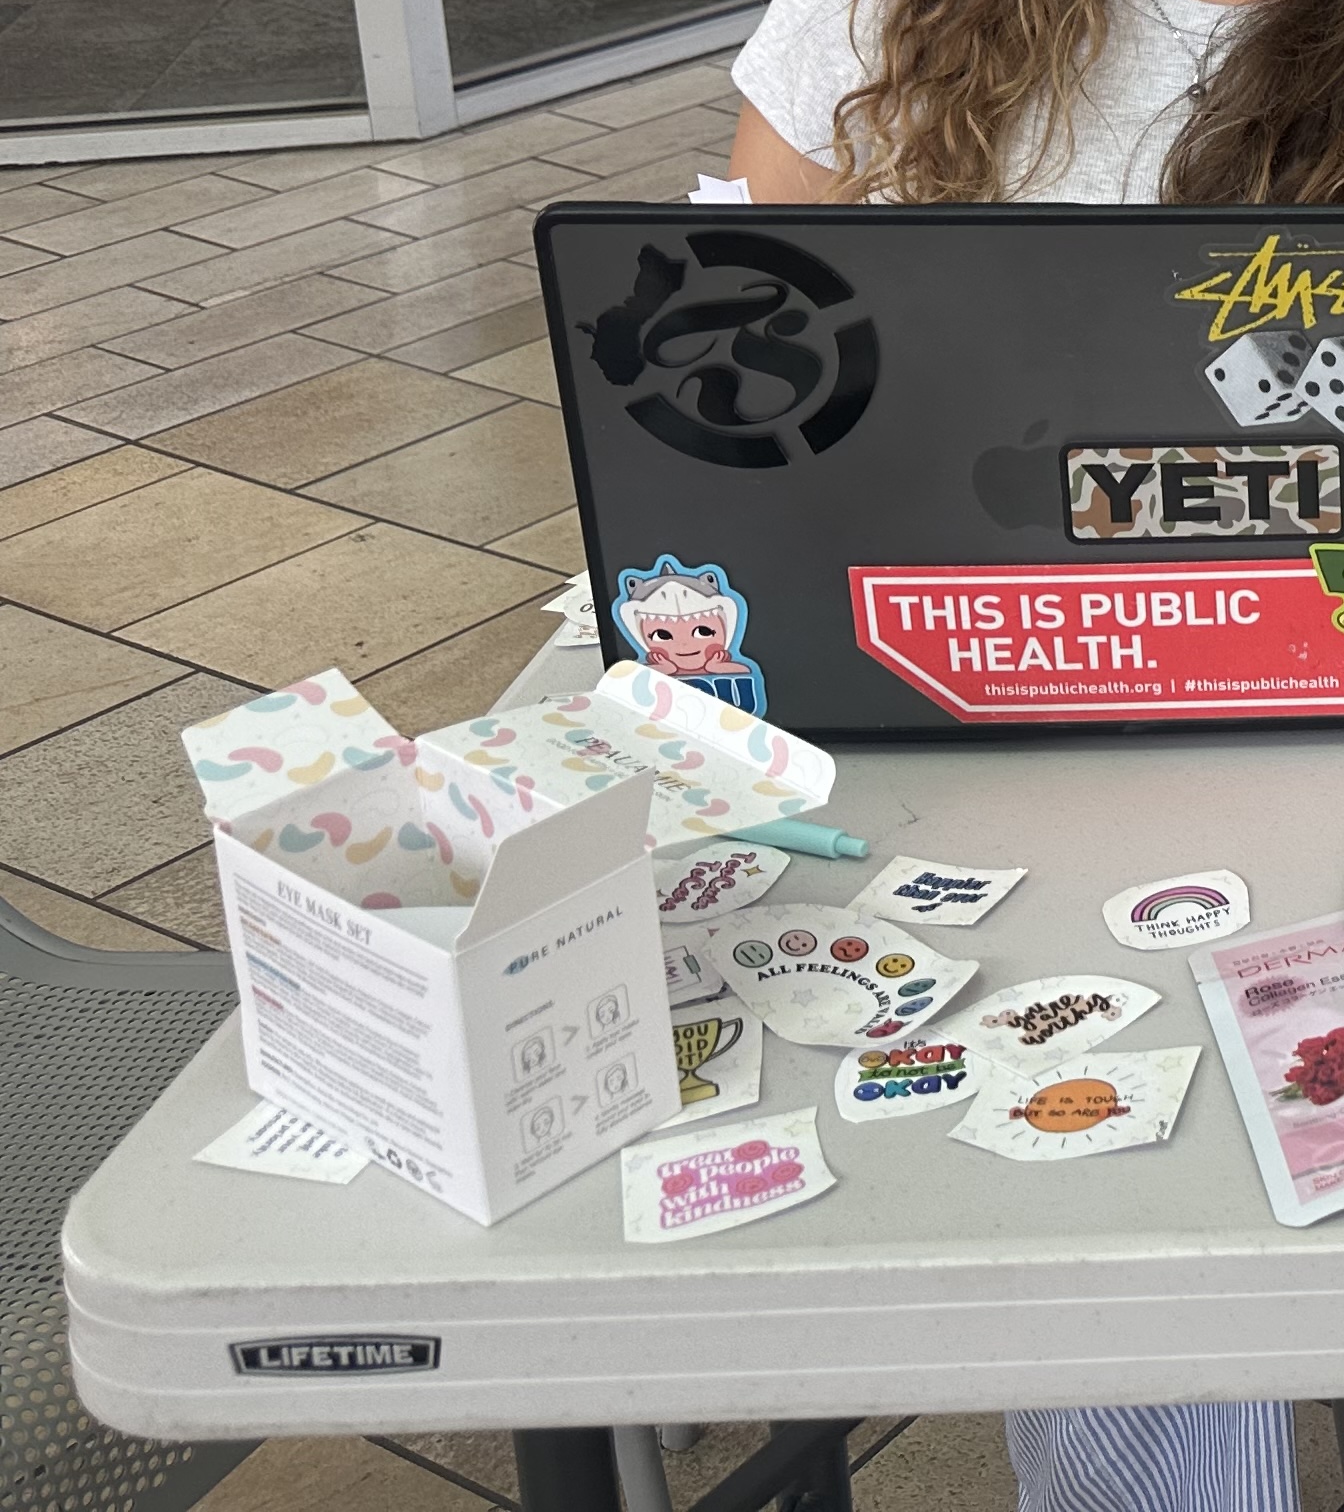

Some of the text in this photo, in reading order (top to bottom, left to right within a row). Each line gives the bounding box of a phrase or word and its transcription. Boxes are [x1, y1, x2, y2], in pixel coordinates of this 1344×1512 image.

[1080, 460, 1321, 523] YETI
[889, 589, 1261, 631] THIS IS PUBLIC
[949, 635, 1159, 672] HEALTH.
[984, 681, 1162, 697] thisispublichealth.org
[1185, 675, 1339, 692] #thisispublichealth
[277, 880, 372, 946] EYE MASK SET
[1134, 907, 1231, 932] THINK HAPPY
[509, 906, 623, 975] PURE NATURAL
[1149, 919, 1221, 939] THOUGHTS
[758, 965, 791, 982] ALL
[796, 963, 878, 991] FEELINGS
[872, 990, 891, 1008] ARE
[1245, 979, 1294, 998] Rose
[1248, 982, 1315, 1007] Collagen
[869, 1061, 957, 1077] to not be
[1013, 1105, 1131, 1118] BUT SO ARE YOU
[1018, 1094, 1134, 1105] LIFE IS TOUGH
[661, 1151, 734, 1177] treat
[700, 1149, 796, 1183] people
[663, 1180, 729, 1210] with
[664, 1180, 802, 1227] kindness
[259, 1344, 414, 1368] LIFETIME
